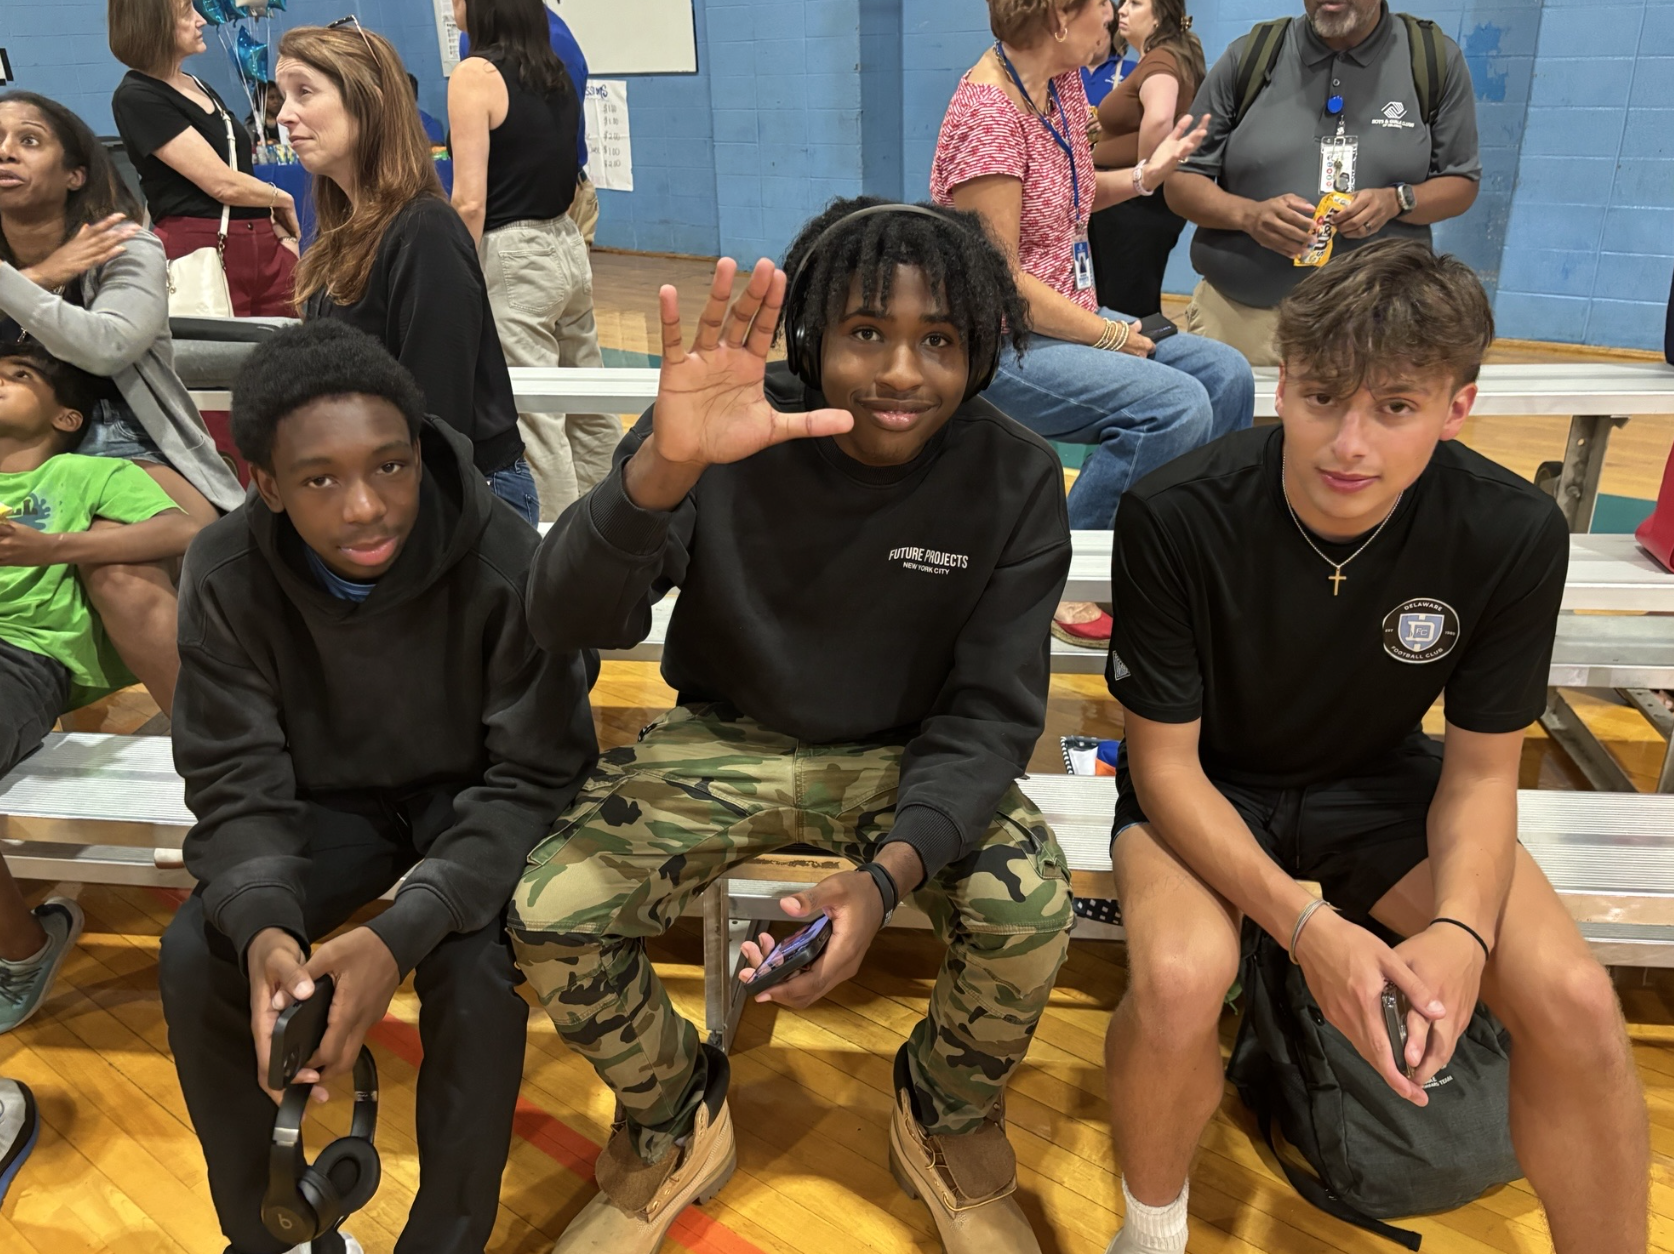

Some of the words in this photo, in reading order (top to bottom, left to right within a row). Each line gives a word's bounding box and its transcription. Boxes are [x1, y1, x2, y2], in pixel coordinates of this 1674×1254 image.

[888, 546, 925, 561] FUTURE
[923, 549, 969, 569] PROJECTS
[902, 561, 918, 570] NEW
[918, 564, 934, 574] YORK
[934, 567, 950, 575] CITY
[1404, 602, 1443, 612] DELAWARE
[1391, 645, 1423, 659] FOOTBALL
[1425, 647, 1444, 658] CLUB
